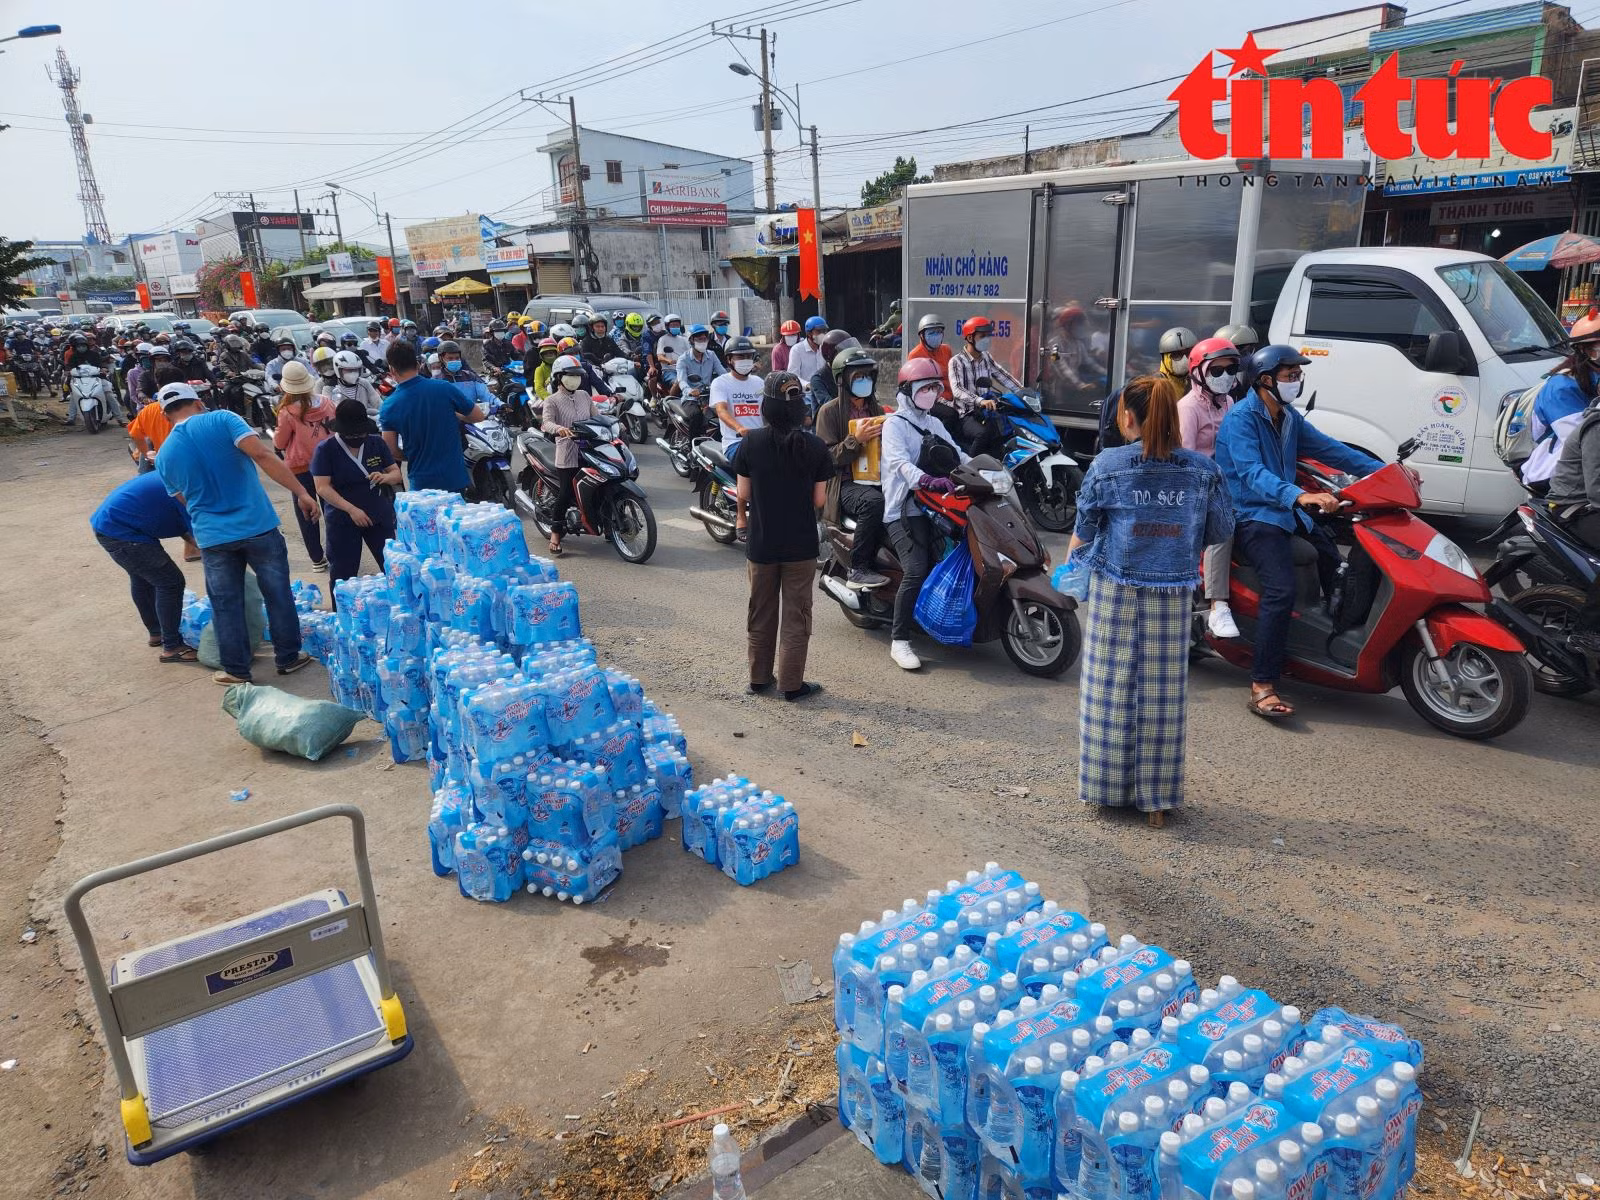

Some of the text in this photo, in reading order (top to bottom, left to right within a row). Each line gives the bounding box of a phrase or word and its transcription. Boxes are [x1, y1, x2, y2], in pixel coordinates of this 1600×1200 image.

[664, 184, 720, 198] AGRIBANK
[1438, 204, 1488, 220] THANH
[926, 253, 952, 281] NHẬN
[979, 250, 1008, 276] HÀNG
[967, 284, 982, 296] 447
[984, 284, 999, 296] 982
[223, 954, 276, 977] PRESTAR
